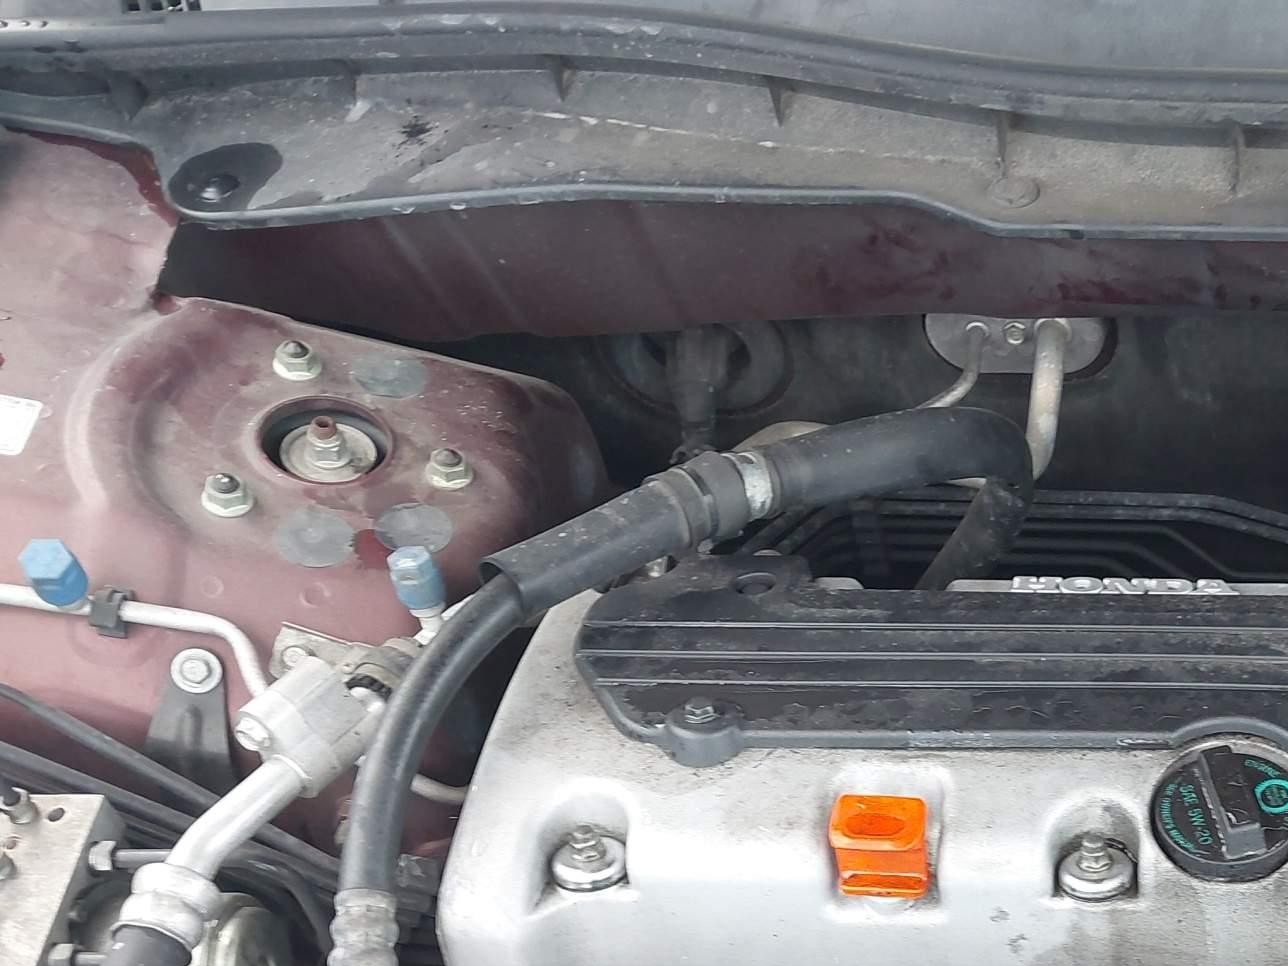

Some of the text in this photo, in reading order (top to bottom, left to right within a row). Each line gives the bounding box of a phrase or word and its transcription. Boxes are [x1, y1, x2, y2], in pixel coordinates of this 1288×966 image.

[1010, 576, 1240, 595] HONDA
[1179, 785, 1213, 845] SAE 5W-20
